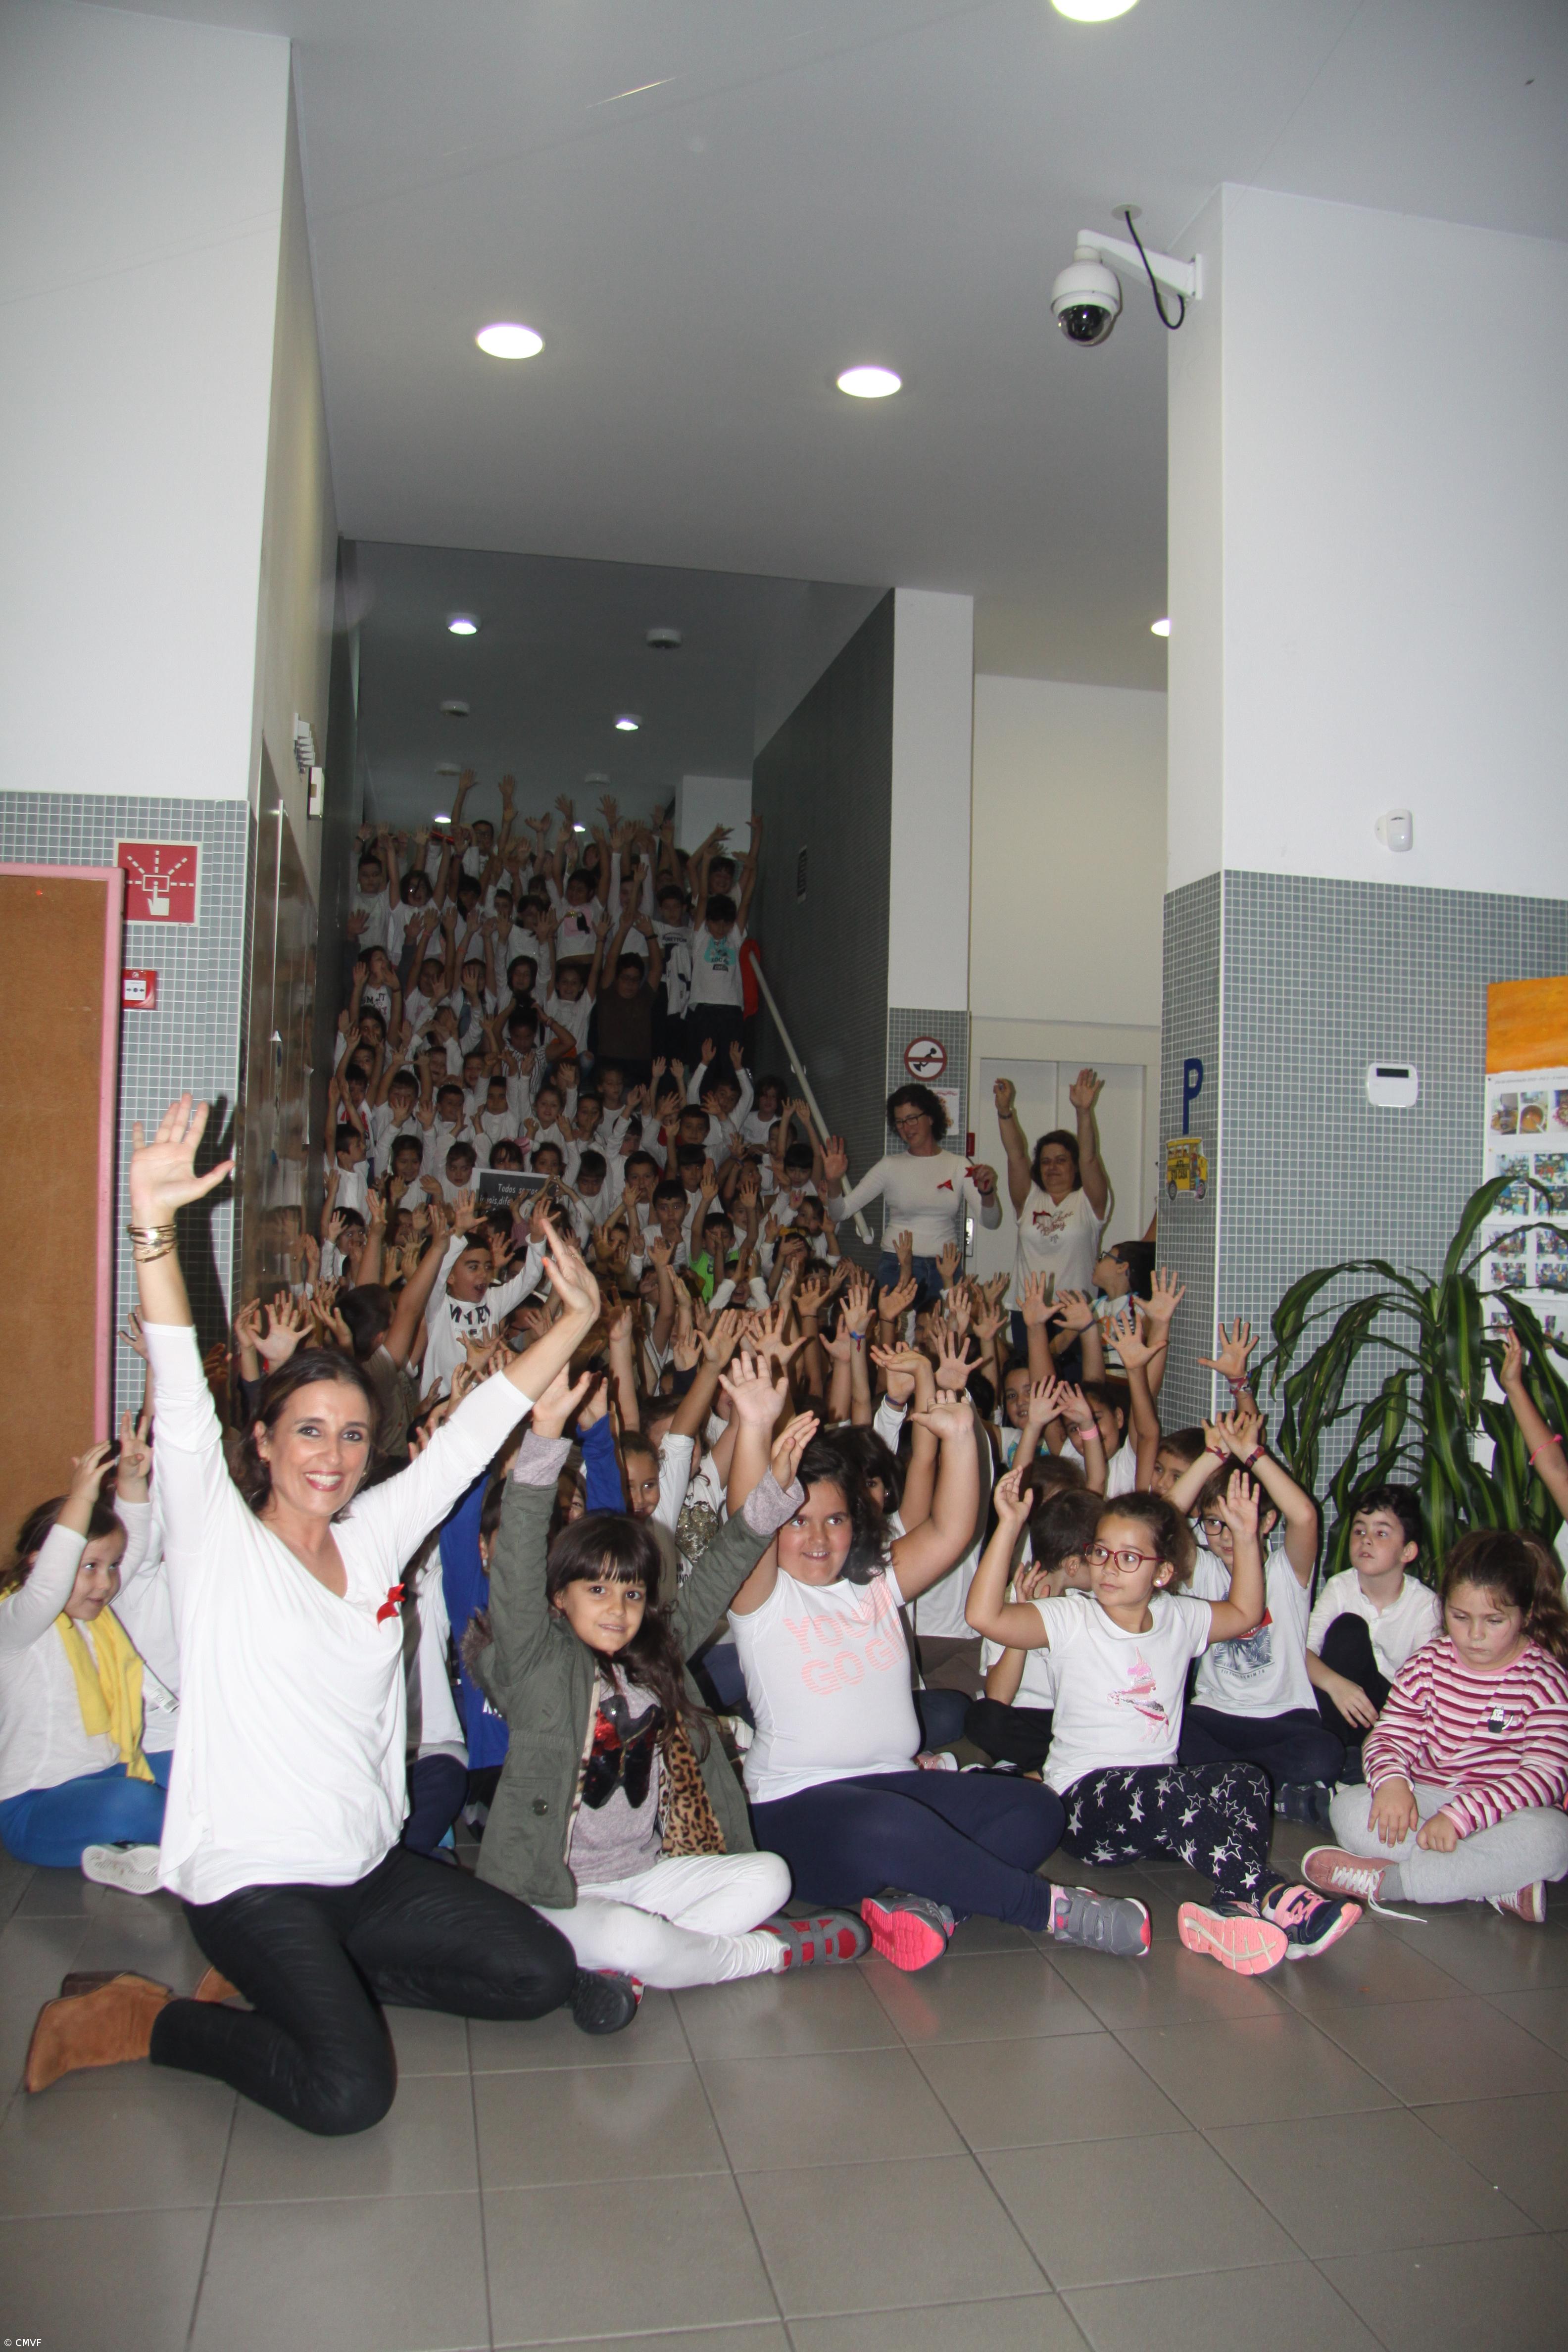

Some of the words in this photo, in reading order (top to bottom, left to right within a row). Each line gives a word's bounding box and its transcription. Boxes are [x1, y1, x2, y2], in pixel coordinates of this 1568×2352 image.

[1182, 1058, 1203, 1135] P
[498, 1183, 516, 1194] Todos
[801, 1651, 865, 1695] GO
